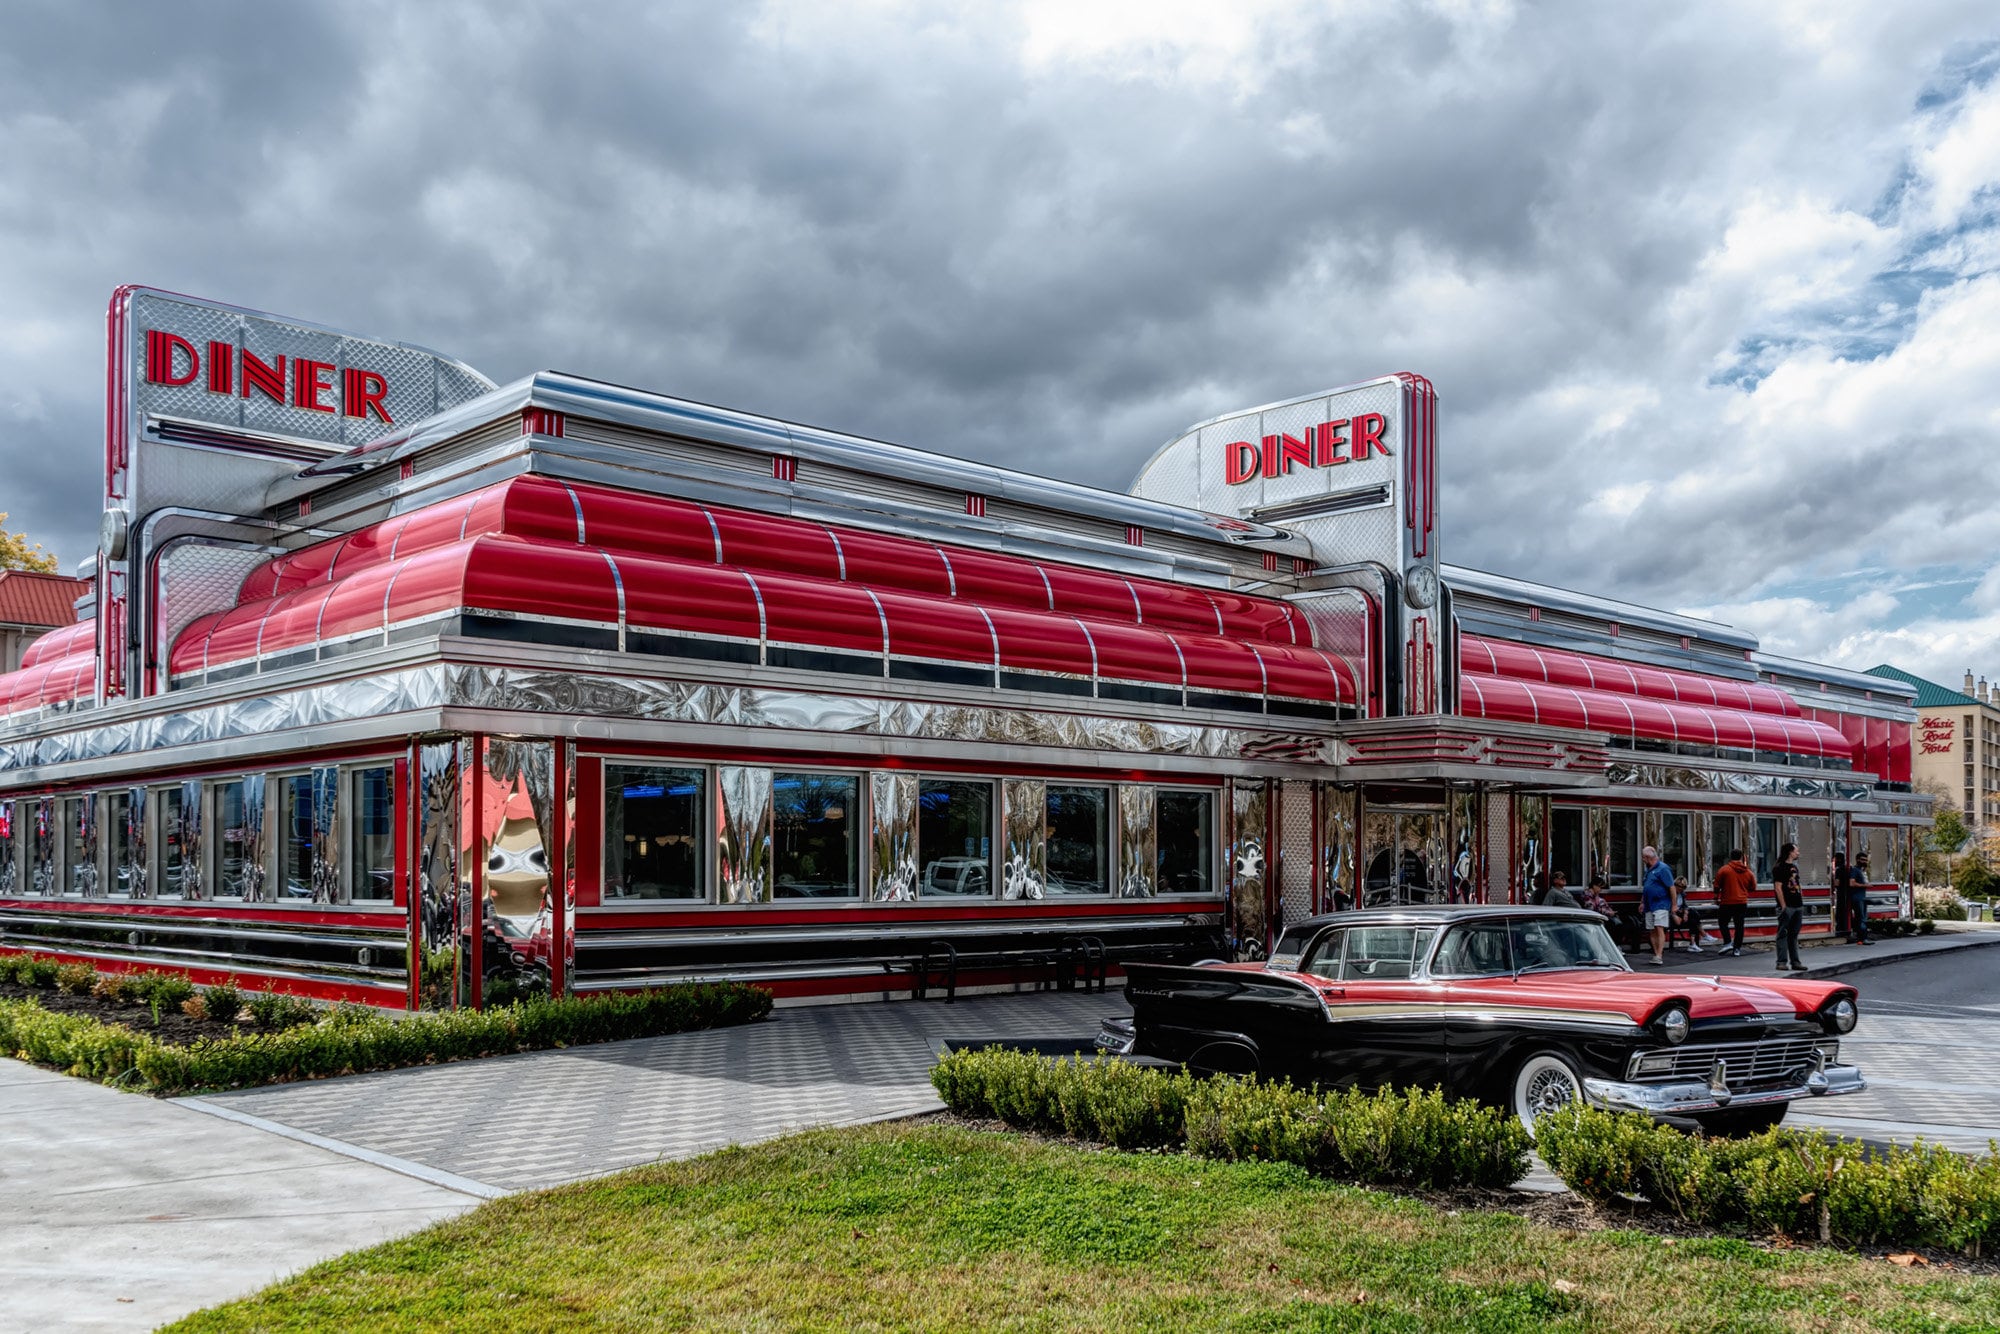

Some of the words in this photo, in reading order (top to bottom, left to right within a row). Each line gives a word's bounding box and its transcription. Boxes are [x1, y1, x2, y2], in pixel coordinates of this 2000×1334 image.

[146, 329, 394, 424] DINER
[1225, 412, 1391, 485] DINER
[1917, 717, 1955, 729] Music
[1917, 729, 1954, 742] Road
[1918, 742, 1953, 755] Hotel
